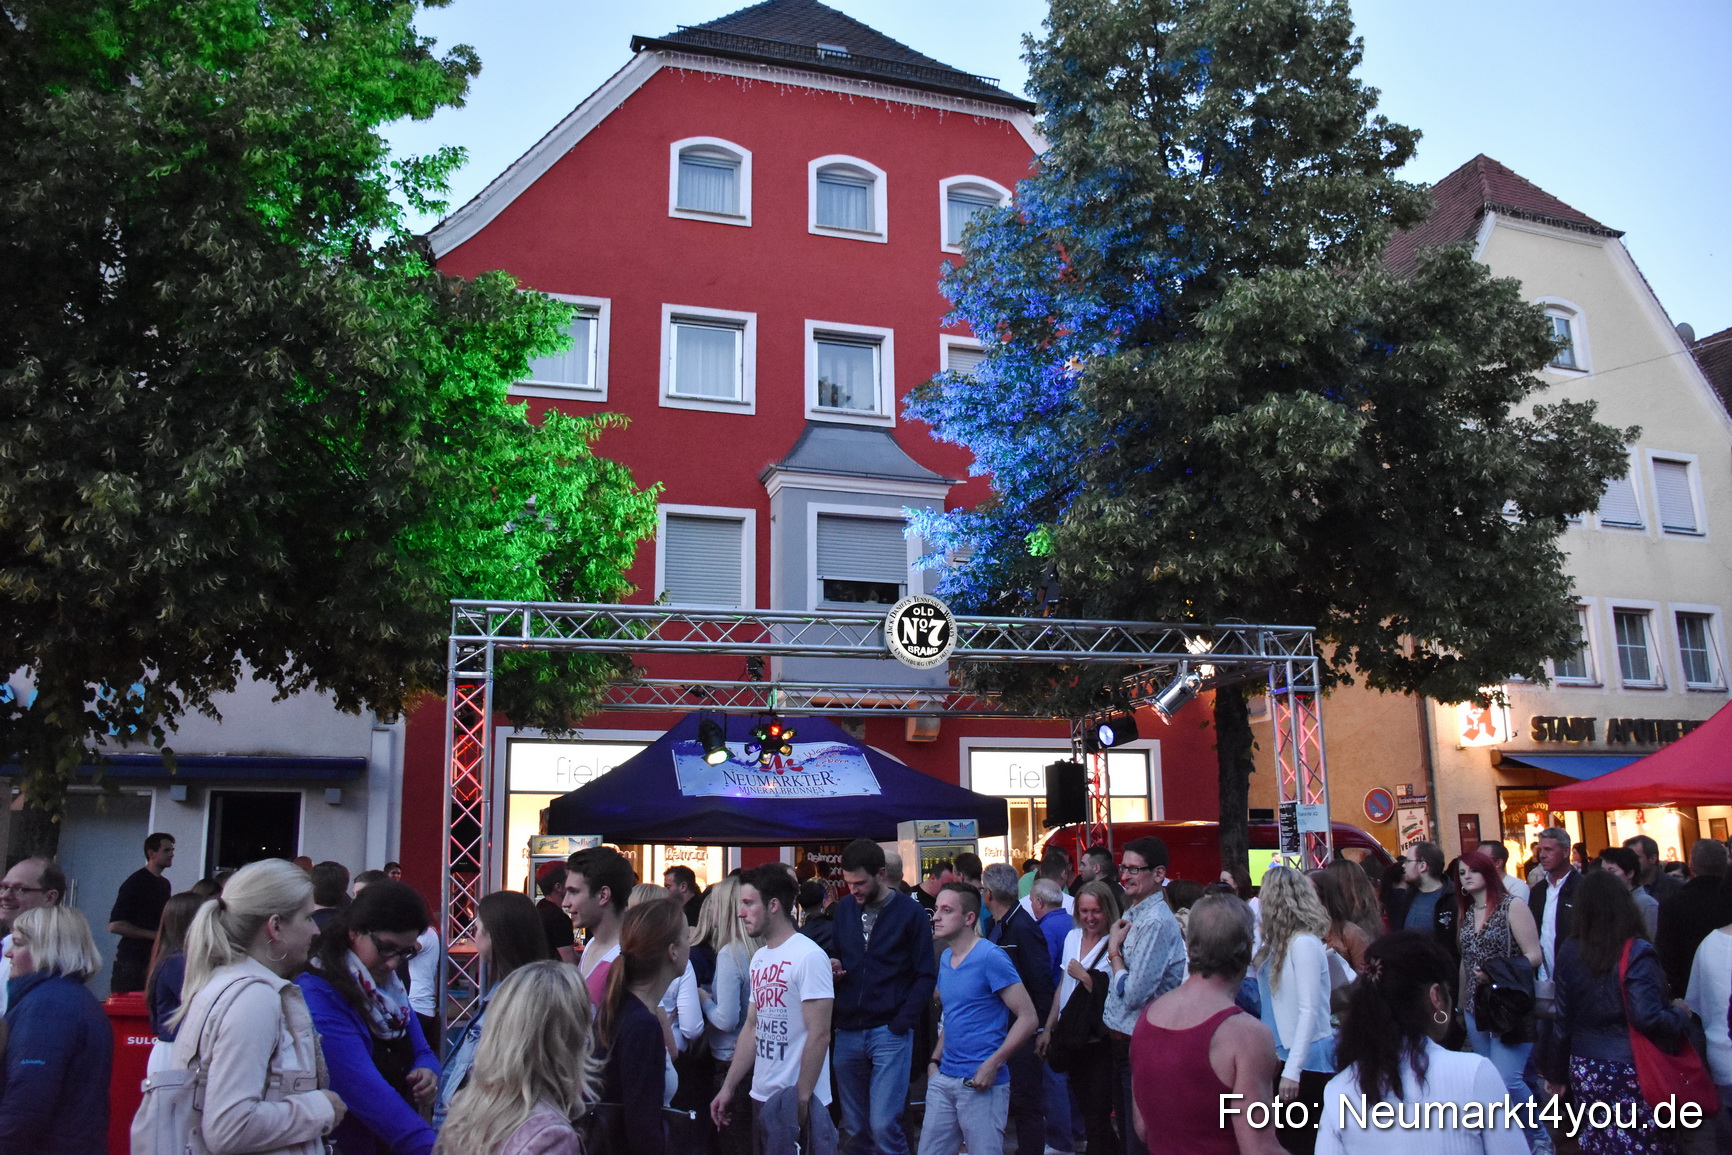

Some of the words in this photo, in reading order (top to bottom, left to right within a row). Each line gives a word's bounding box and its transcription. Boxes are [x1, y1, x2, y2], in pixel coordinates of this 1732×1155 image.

[913, 606, 934, 616] OLD
[908, 645, 938, 656] BRAND
[1531, 715, 1597, 742] STADT
[722, 770, 836, 788] NEUMARKTER
[738, 786, 825, 795] MINERALBRUNNEN
[751, 960, 792, 992] MADE
[761, 1032, 788, 1042] LONDON
